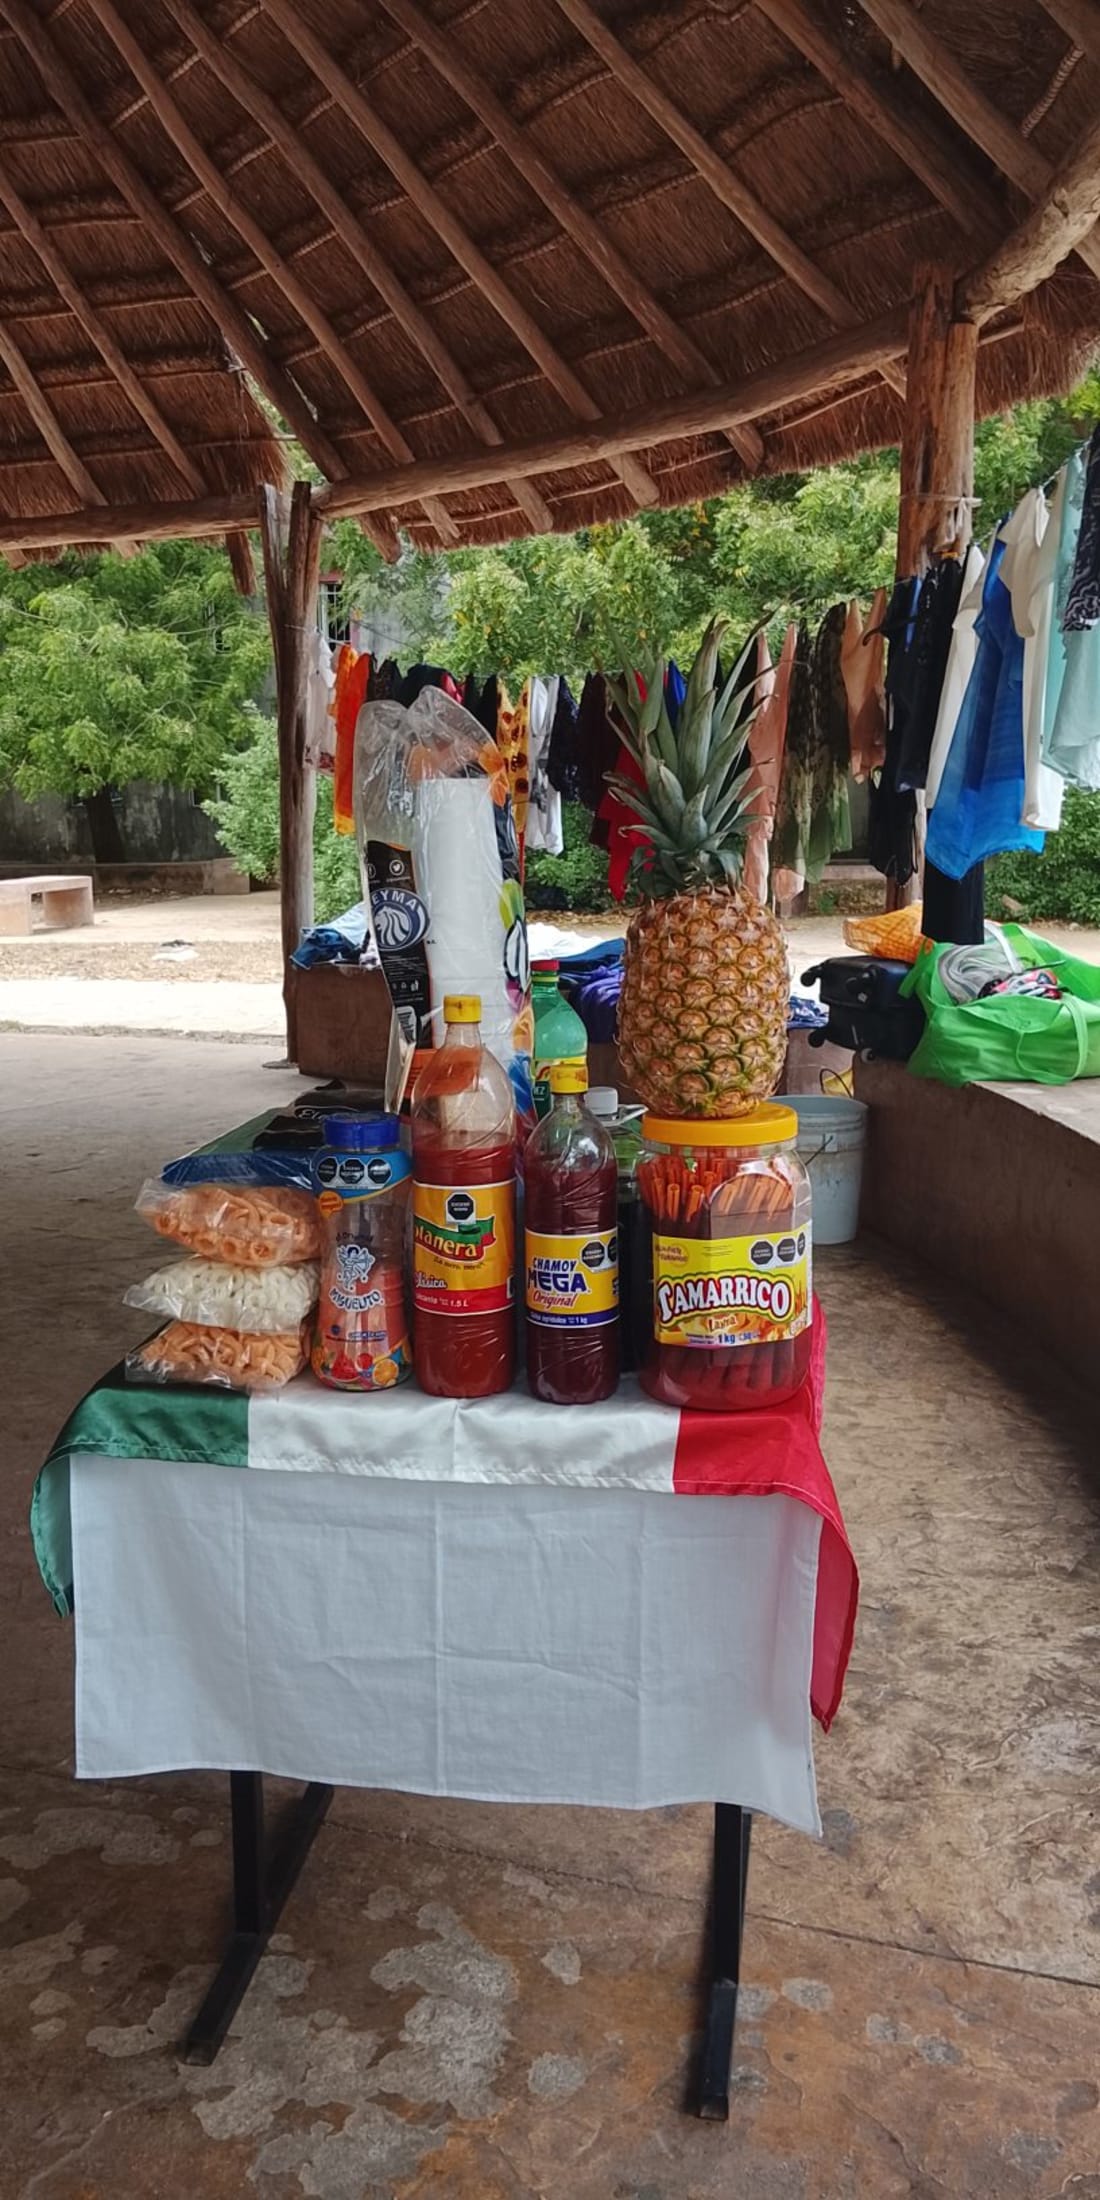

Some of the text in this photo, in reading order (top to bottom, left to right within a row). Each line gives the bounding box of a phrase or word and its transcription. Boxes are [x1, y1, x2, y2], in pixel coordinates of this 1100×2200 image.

[371, 889, 418, 911] EYMA
[533, 1257, 577, 1272] CHAMOY
[527, 1267, 587, 1293] MEGA
[329, 1286, 381, 1311] MIGUELITO
[533, 1290, 578, 1308] Original
[657, 1276, 790, 1322] TAMARRICO
[724, 1333, 735, 1344] kg
